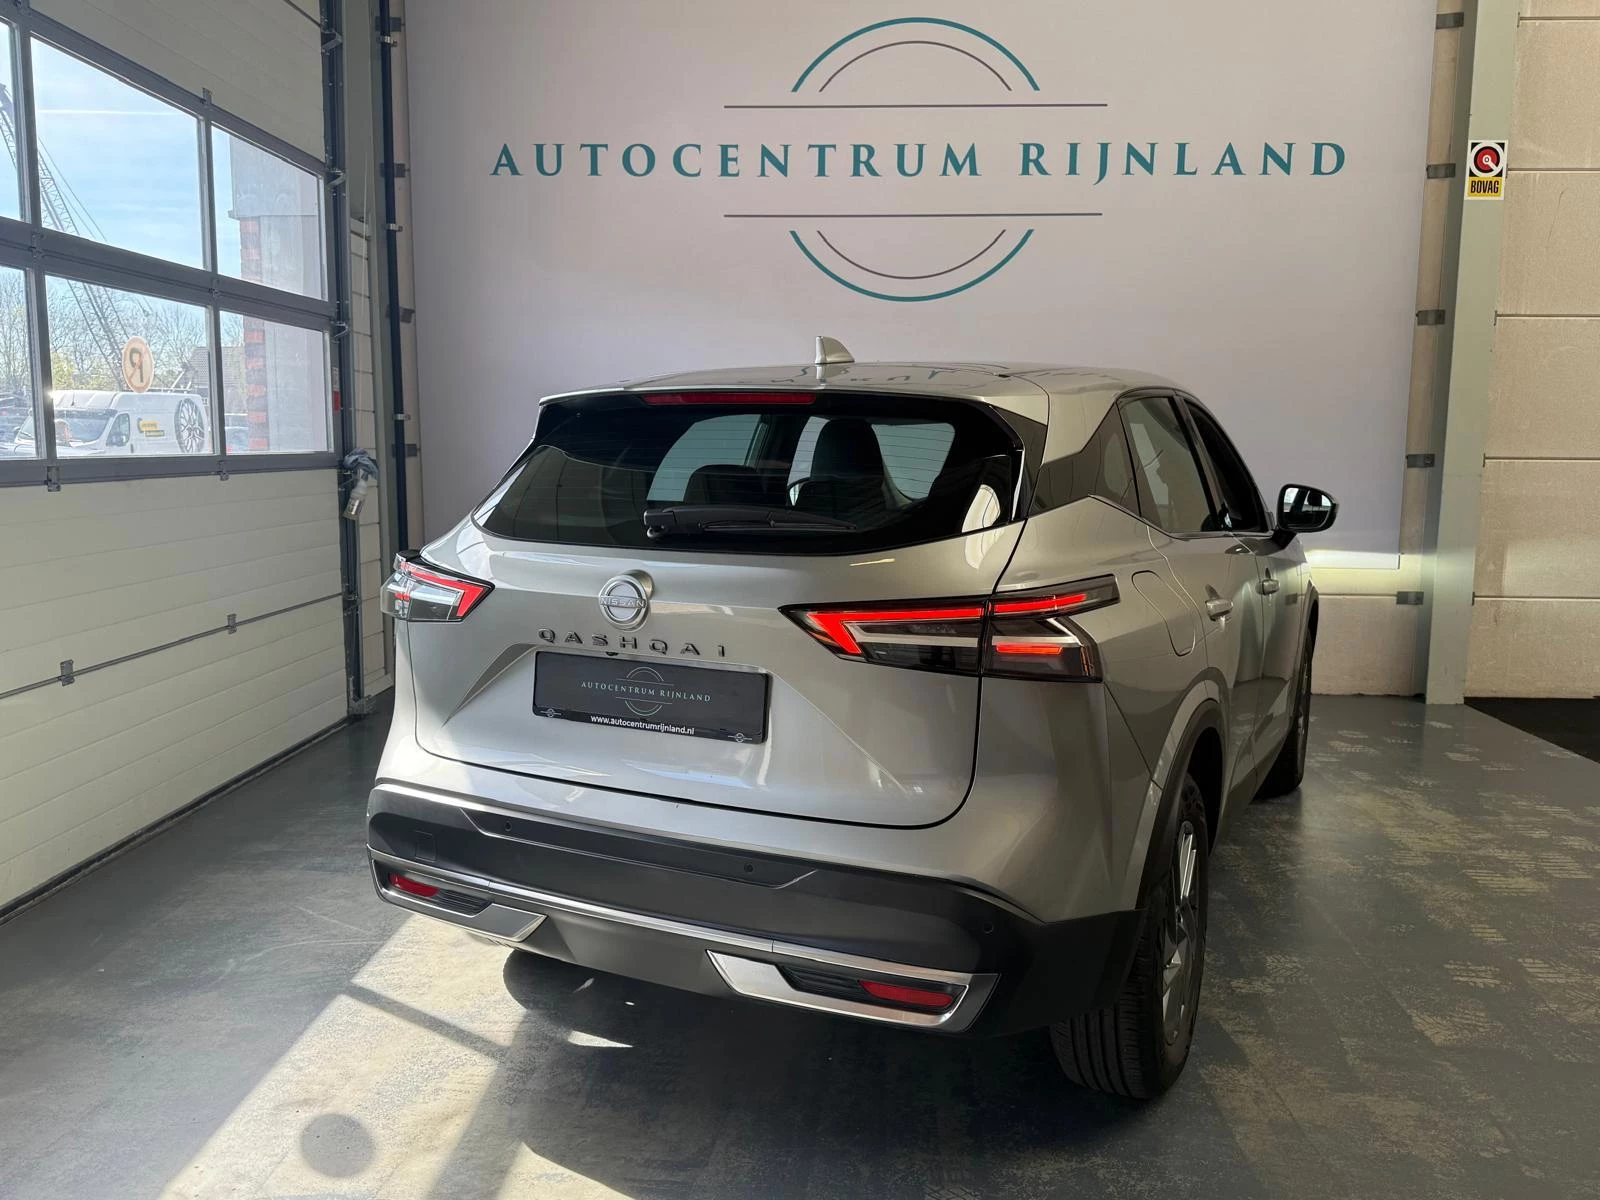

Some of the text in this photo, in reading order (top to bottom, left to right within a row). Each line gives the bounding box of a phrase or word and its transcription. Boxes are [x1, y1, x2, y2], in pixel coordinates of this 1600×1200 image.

[489, 142, 1346, 185] AUTOCENTRUM RIJNLAND
[1470, 180, 1499, 193] BOVAG
[601, 597, 645, 607] NISSAN
[538, 628, 727, 657] QASHQAI
[581, 681, 711, 702] AUTOCENTRUM RIJNLAND
[590, 715, 695, 735] www.autocentrumrijnland.nl
